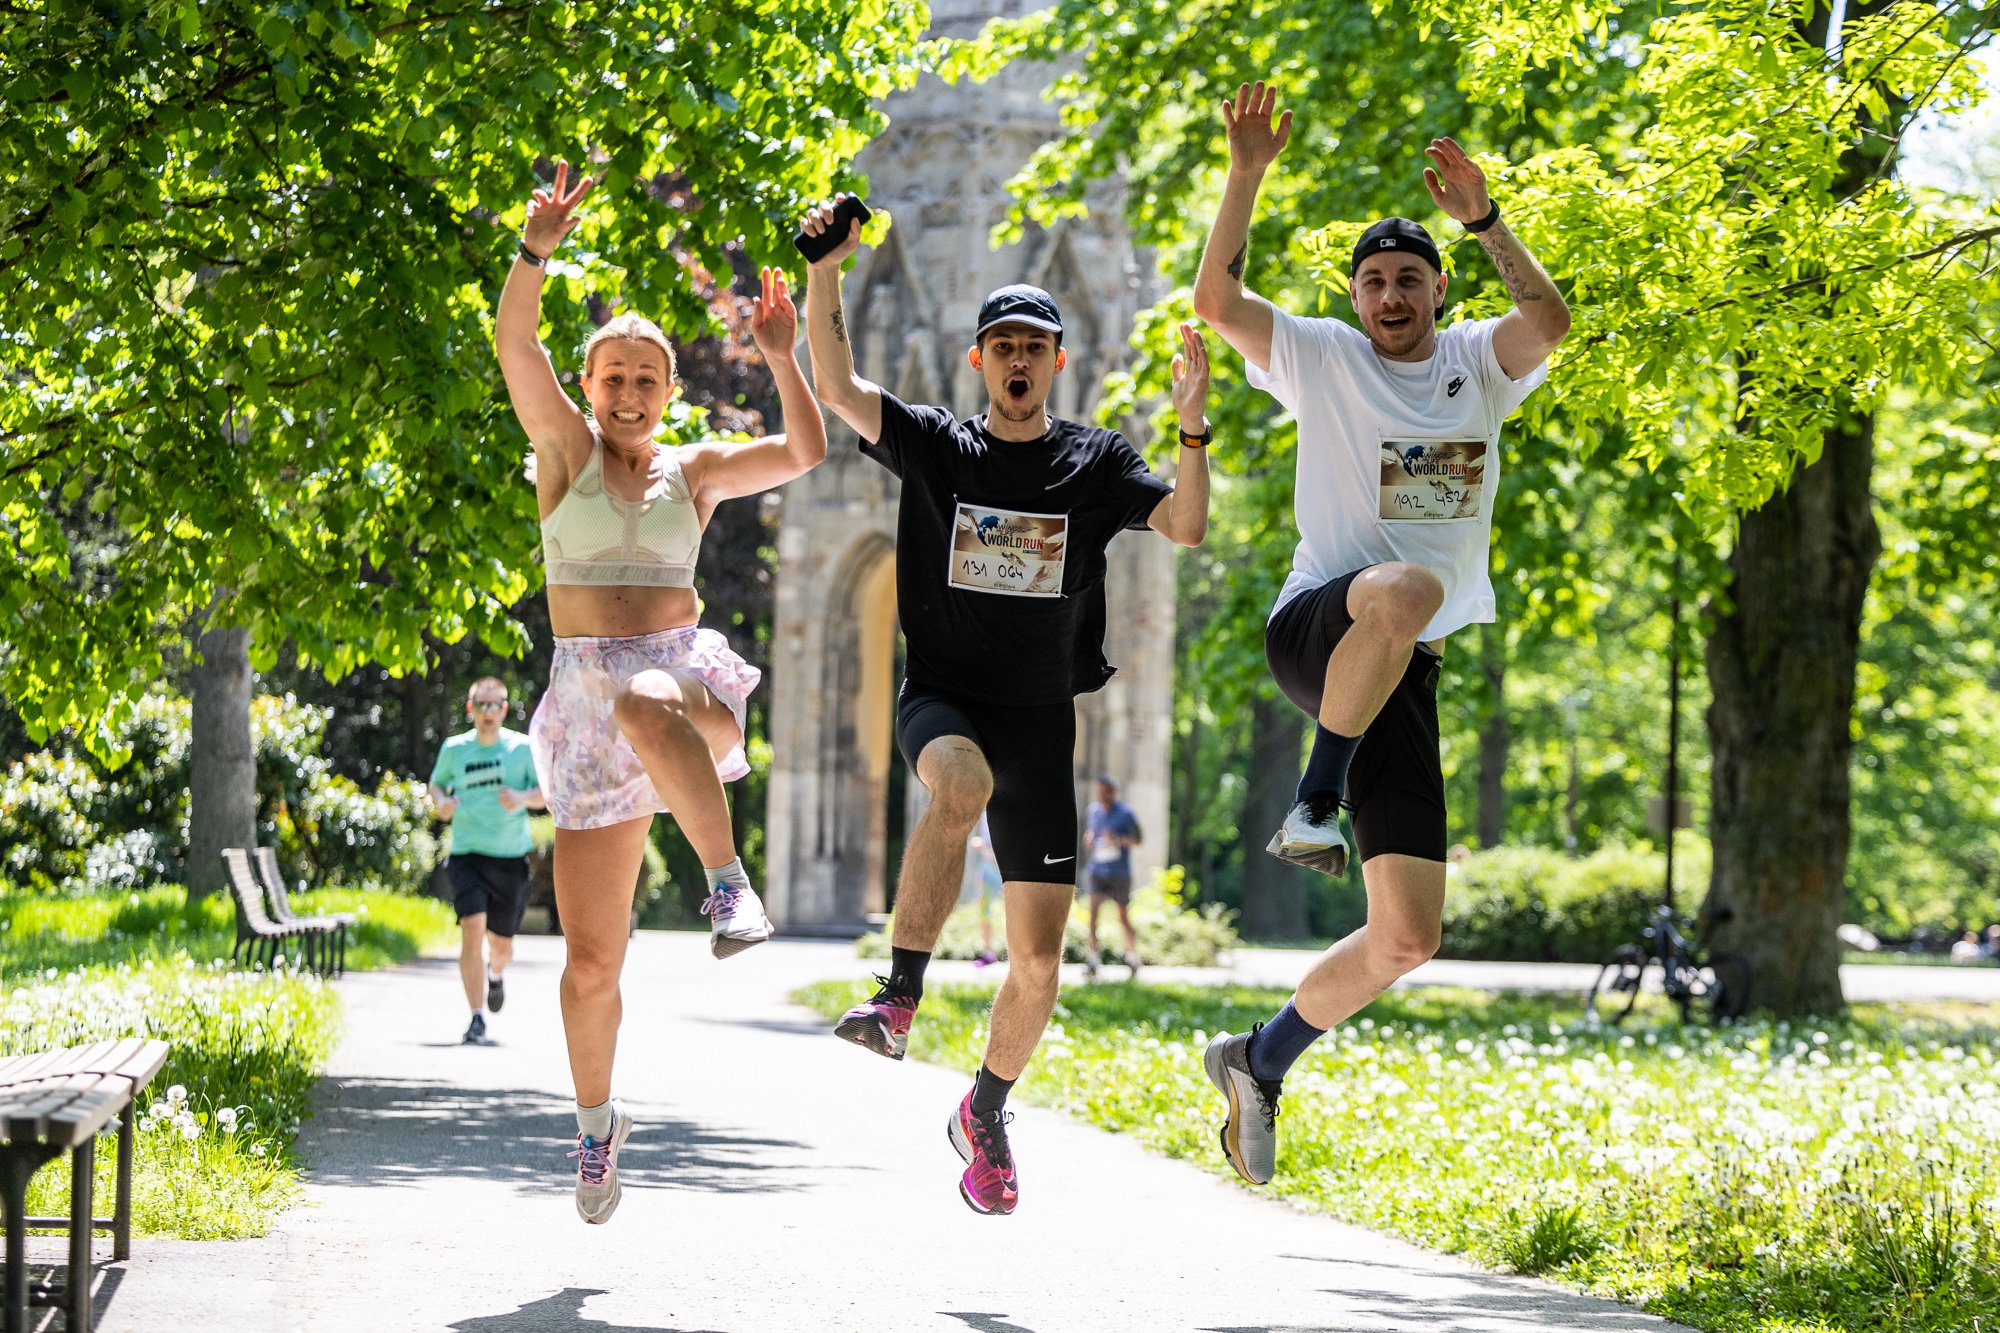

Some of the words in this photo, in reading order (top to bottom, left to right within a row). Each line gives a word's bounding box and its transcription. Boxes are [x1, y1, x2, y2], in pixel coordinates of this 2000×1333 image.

[1414, 464, 1448, 475] WORLD
[1449, 464, 1467, 475] RUN
[1394, 493, 1425, 510] 192
[1435, 491, 1462, 506] 452
[988, 534, 1022, 549] WORLD
[1023, 538, 1044, 550] RUN
[962, 559, 988, 577] 131
[998, 564, 1024, 580] 064
